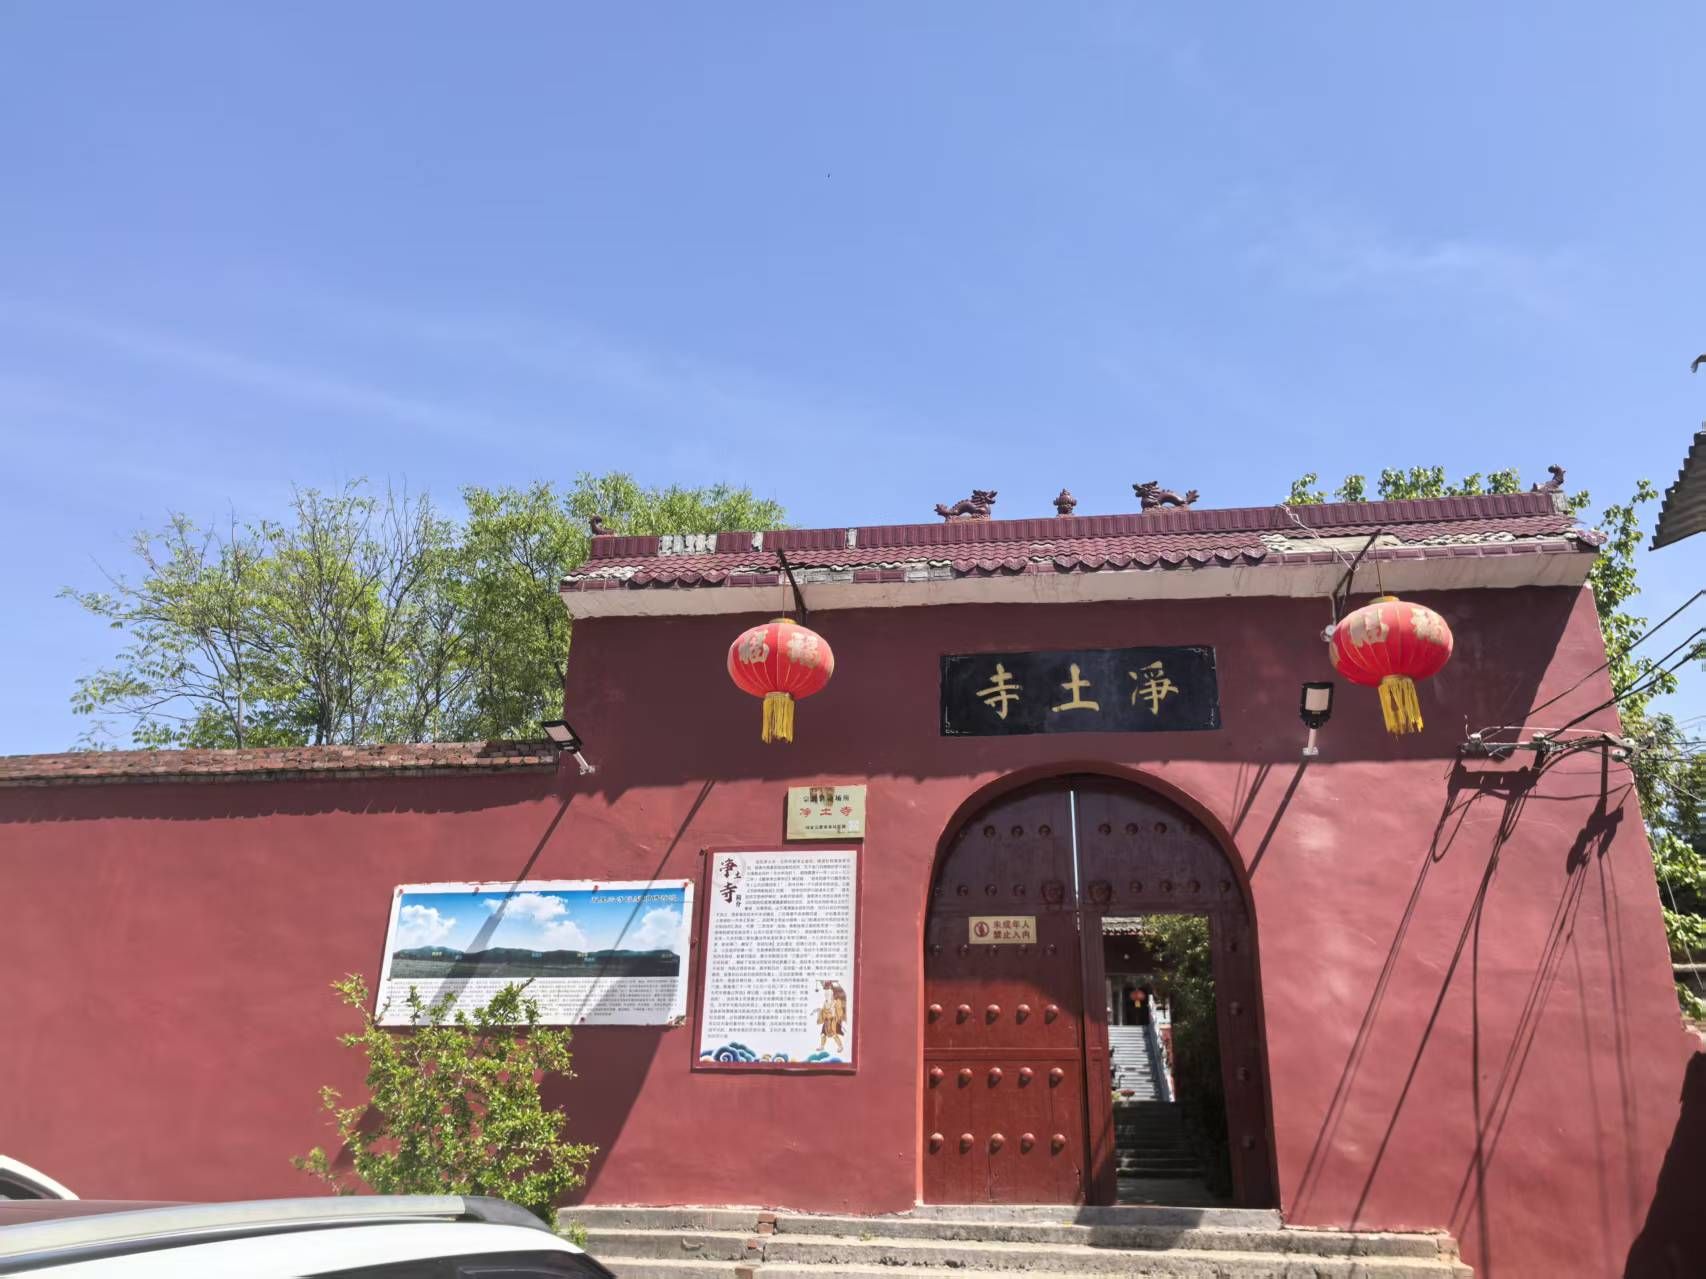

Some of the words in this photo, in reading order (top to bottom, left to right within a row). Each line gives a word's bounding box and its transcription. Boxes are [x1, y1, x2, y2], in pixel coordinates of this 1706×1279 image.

[993, 919, 1030, 929] 未成年人
[993, 930, 1031, 939] 禁止入内
